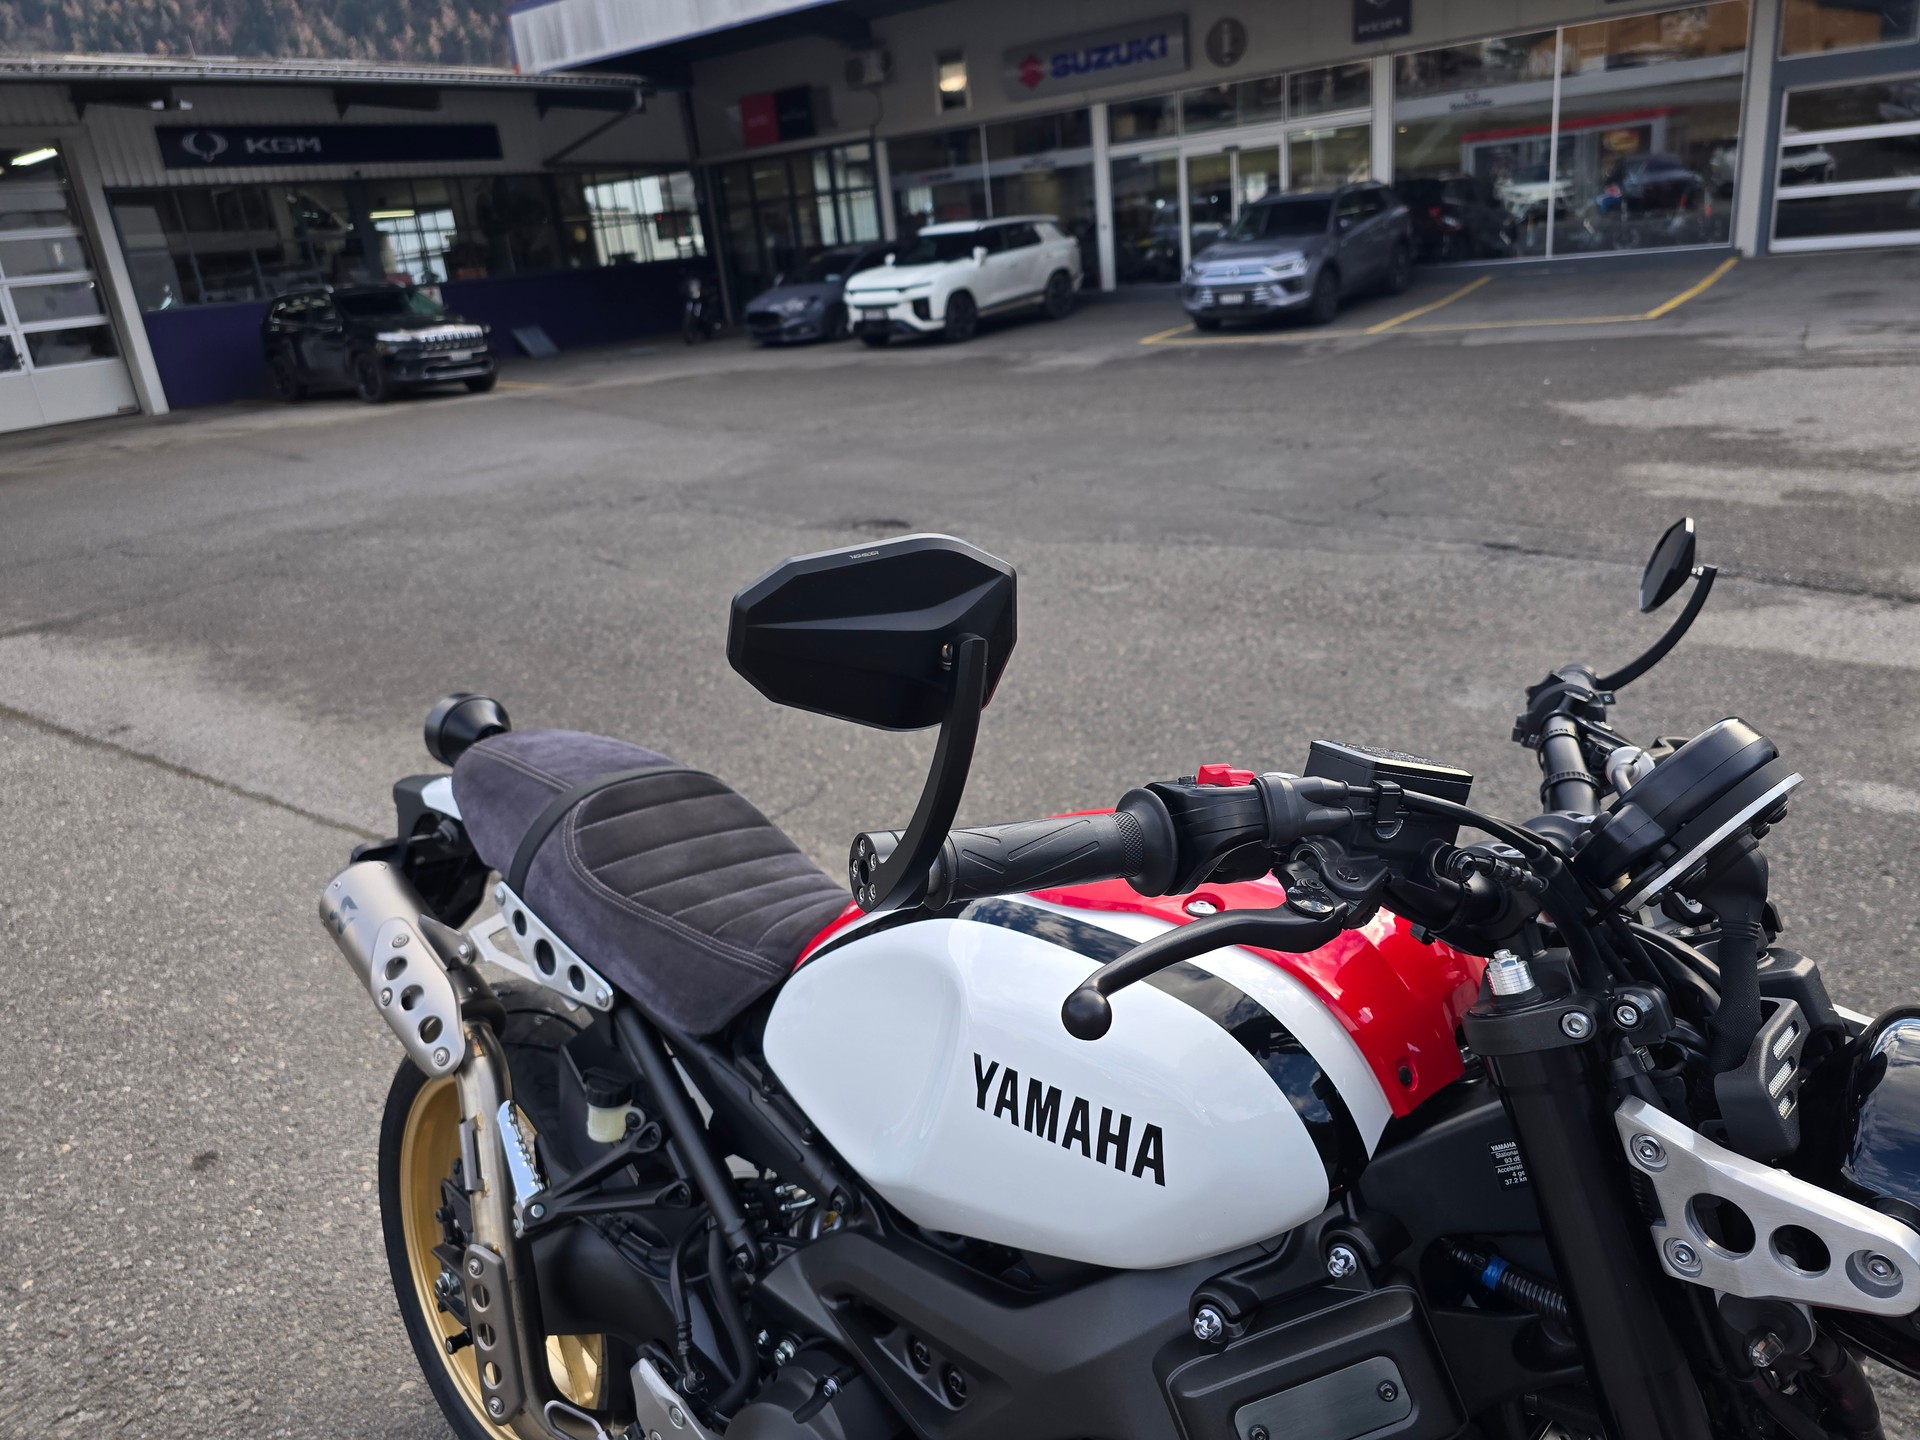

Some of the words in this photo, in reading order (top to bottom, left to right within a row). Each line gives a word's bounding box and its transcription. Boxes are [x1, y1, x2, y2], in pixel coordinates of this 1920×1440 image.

[1050, 33, 1167, 78] SUZUKI
[245, 136, 322, 154] KGM
[974, 1052, 1166, 1187] YAMAHA
[1491, 1142, 1516, 1151] YAMAHA
